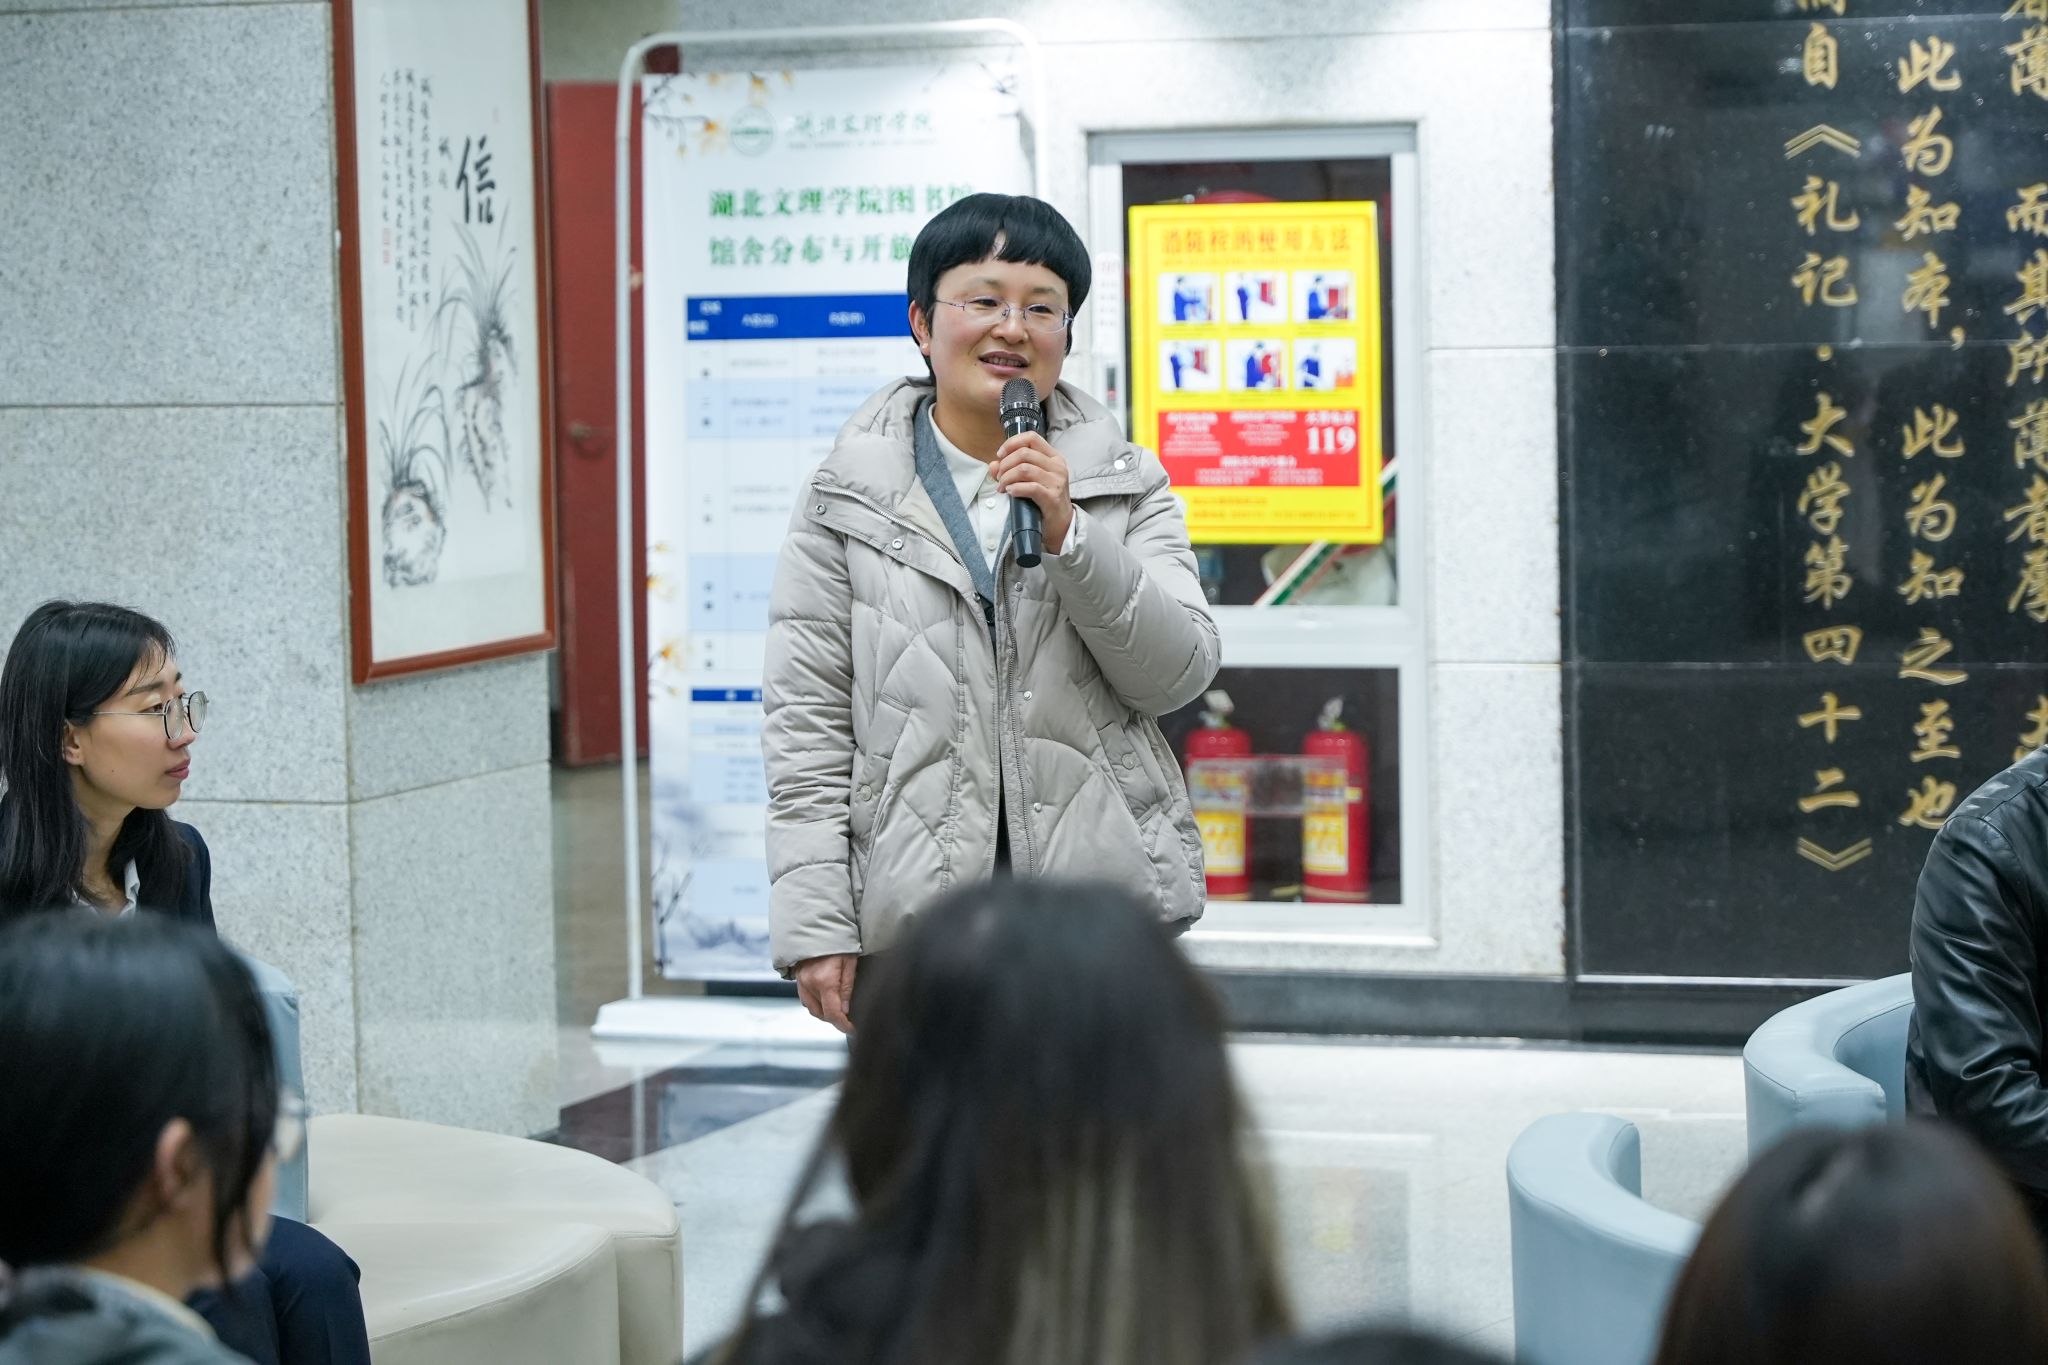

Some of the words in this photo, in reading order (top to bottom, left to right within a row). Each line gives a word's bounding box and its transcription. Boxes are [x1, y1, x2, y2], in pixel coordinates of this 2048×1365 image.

[456, 133, 496, 224] 信
[1306, 425, 1357, 455] 119
[1784, 0, 1872, 871] 自《礼记·大学第四十二》
